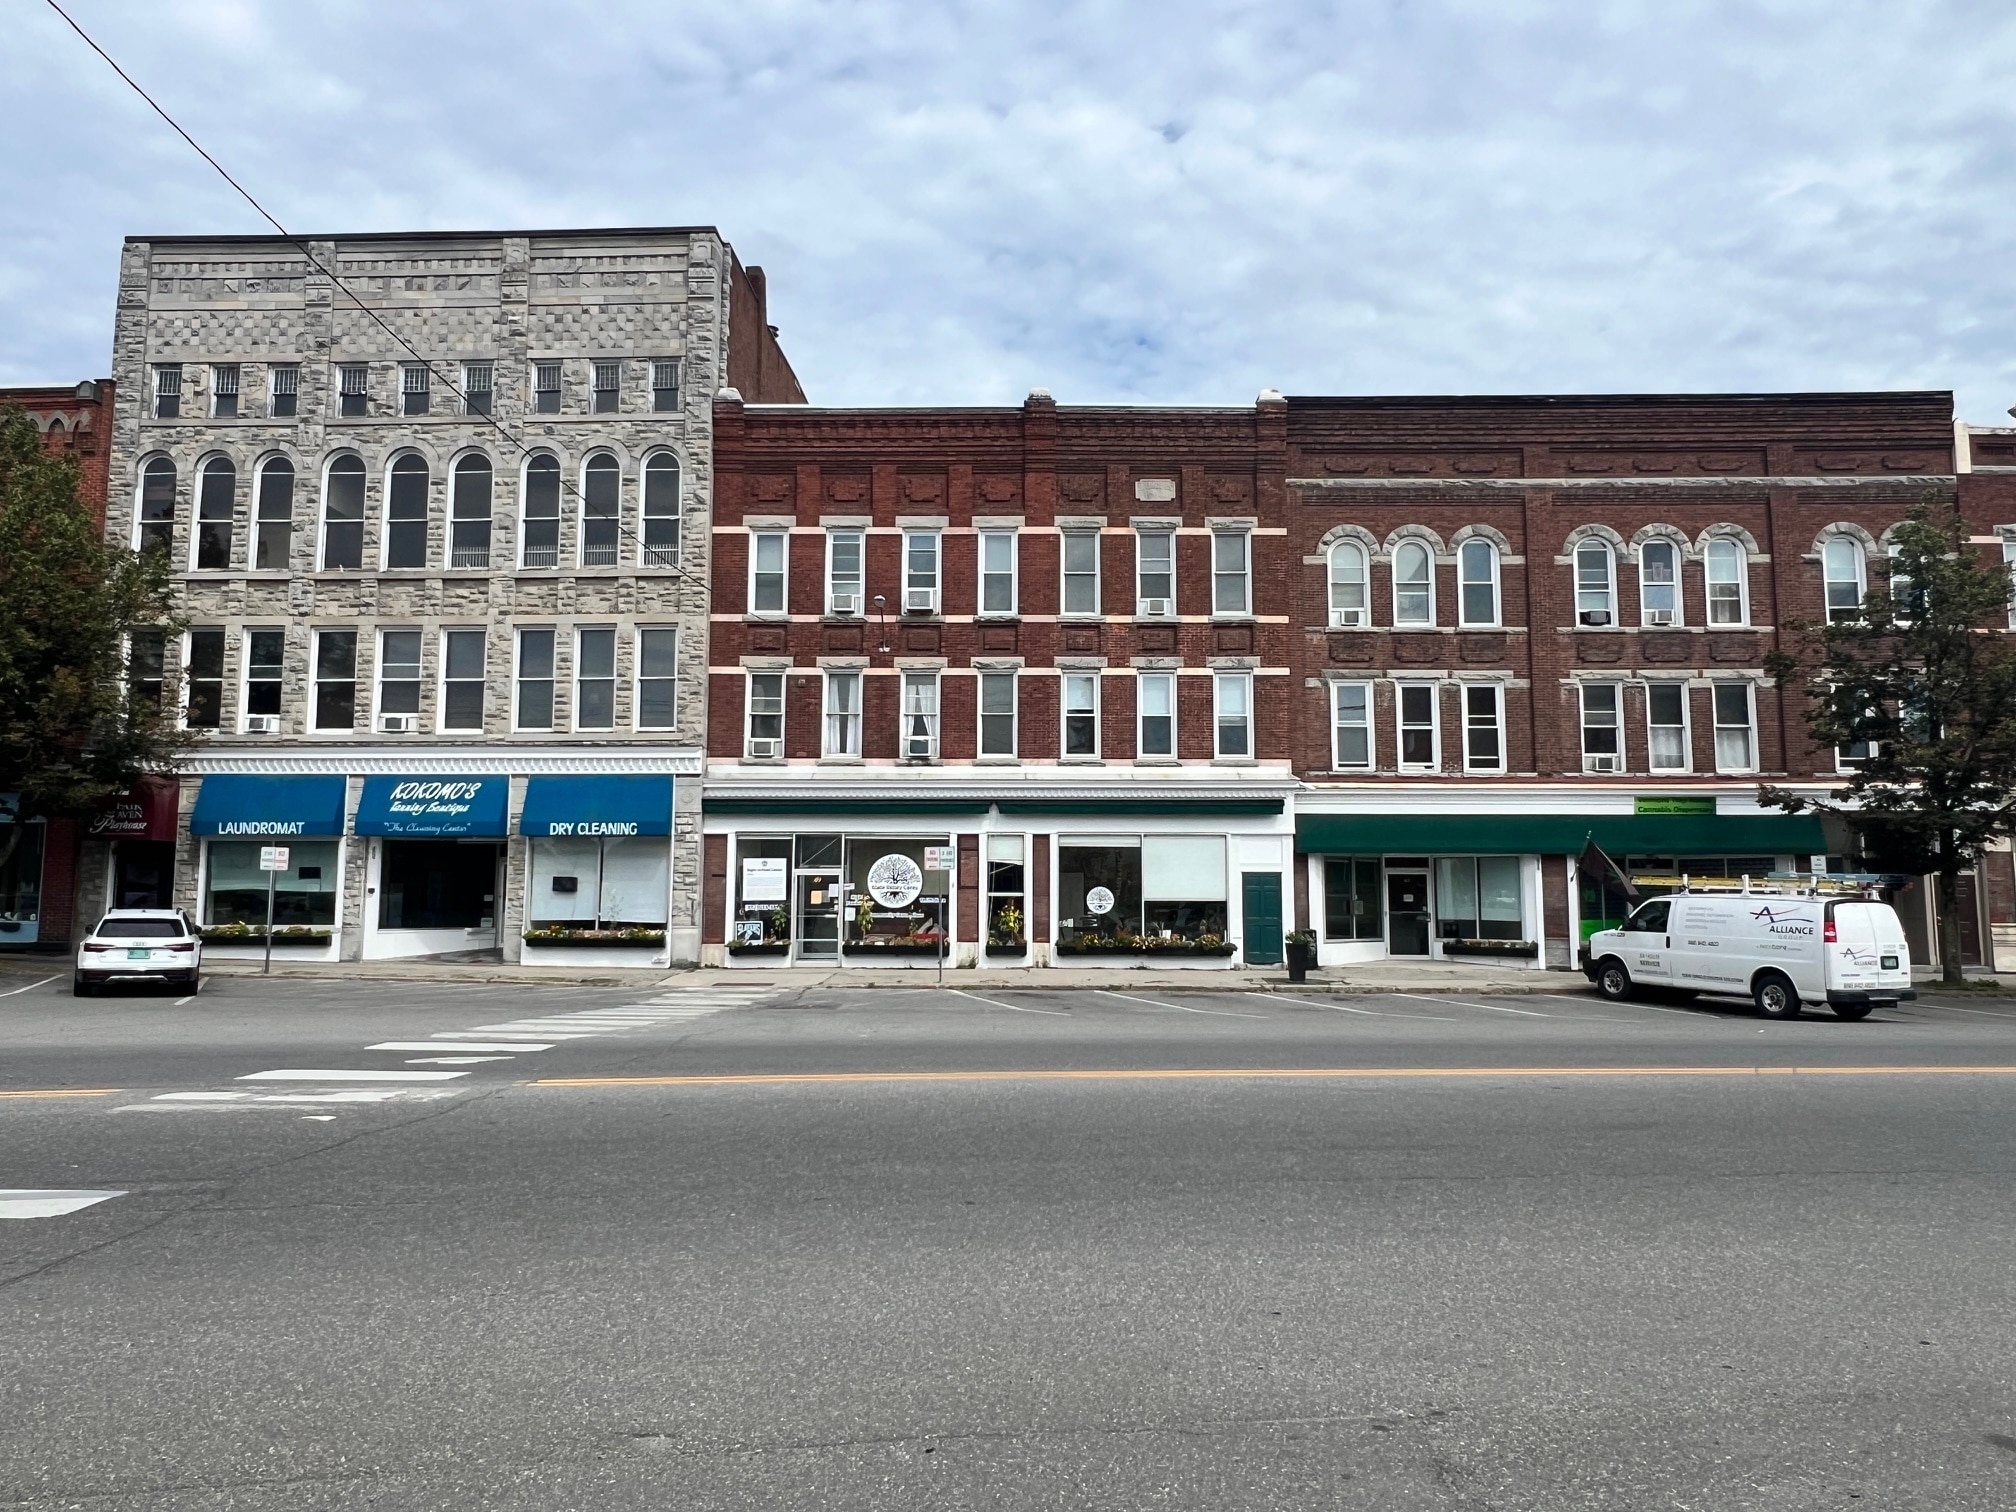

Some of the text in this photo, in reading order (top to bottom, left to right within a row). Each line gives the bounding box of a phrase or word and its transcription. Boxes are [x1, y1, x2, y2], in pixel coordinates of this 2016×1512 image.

[390, 782, 482, 800] KOKOMO'S
[218, 821, 305, 835] LAUNDROMAT
[549, 822, 638, 836] DRY CLEANING
[1769, 925, 1814, 935] ALLIANCE
